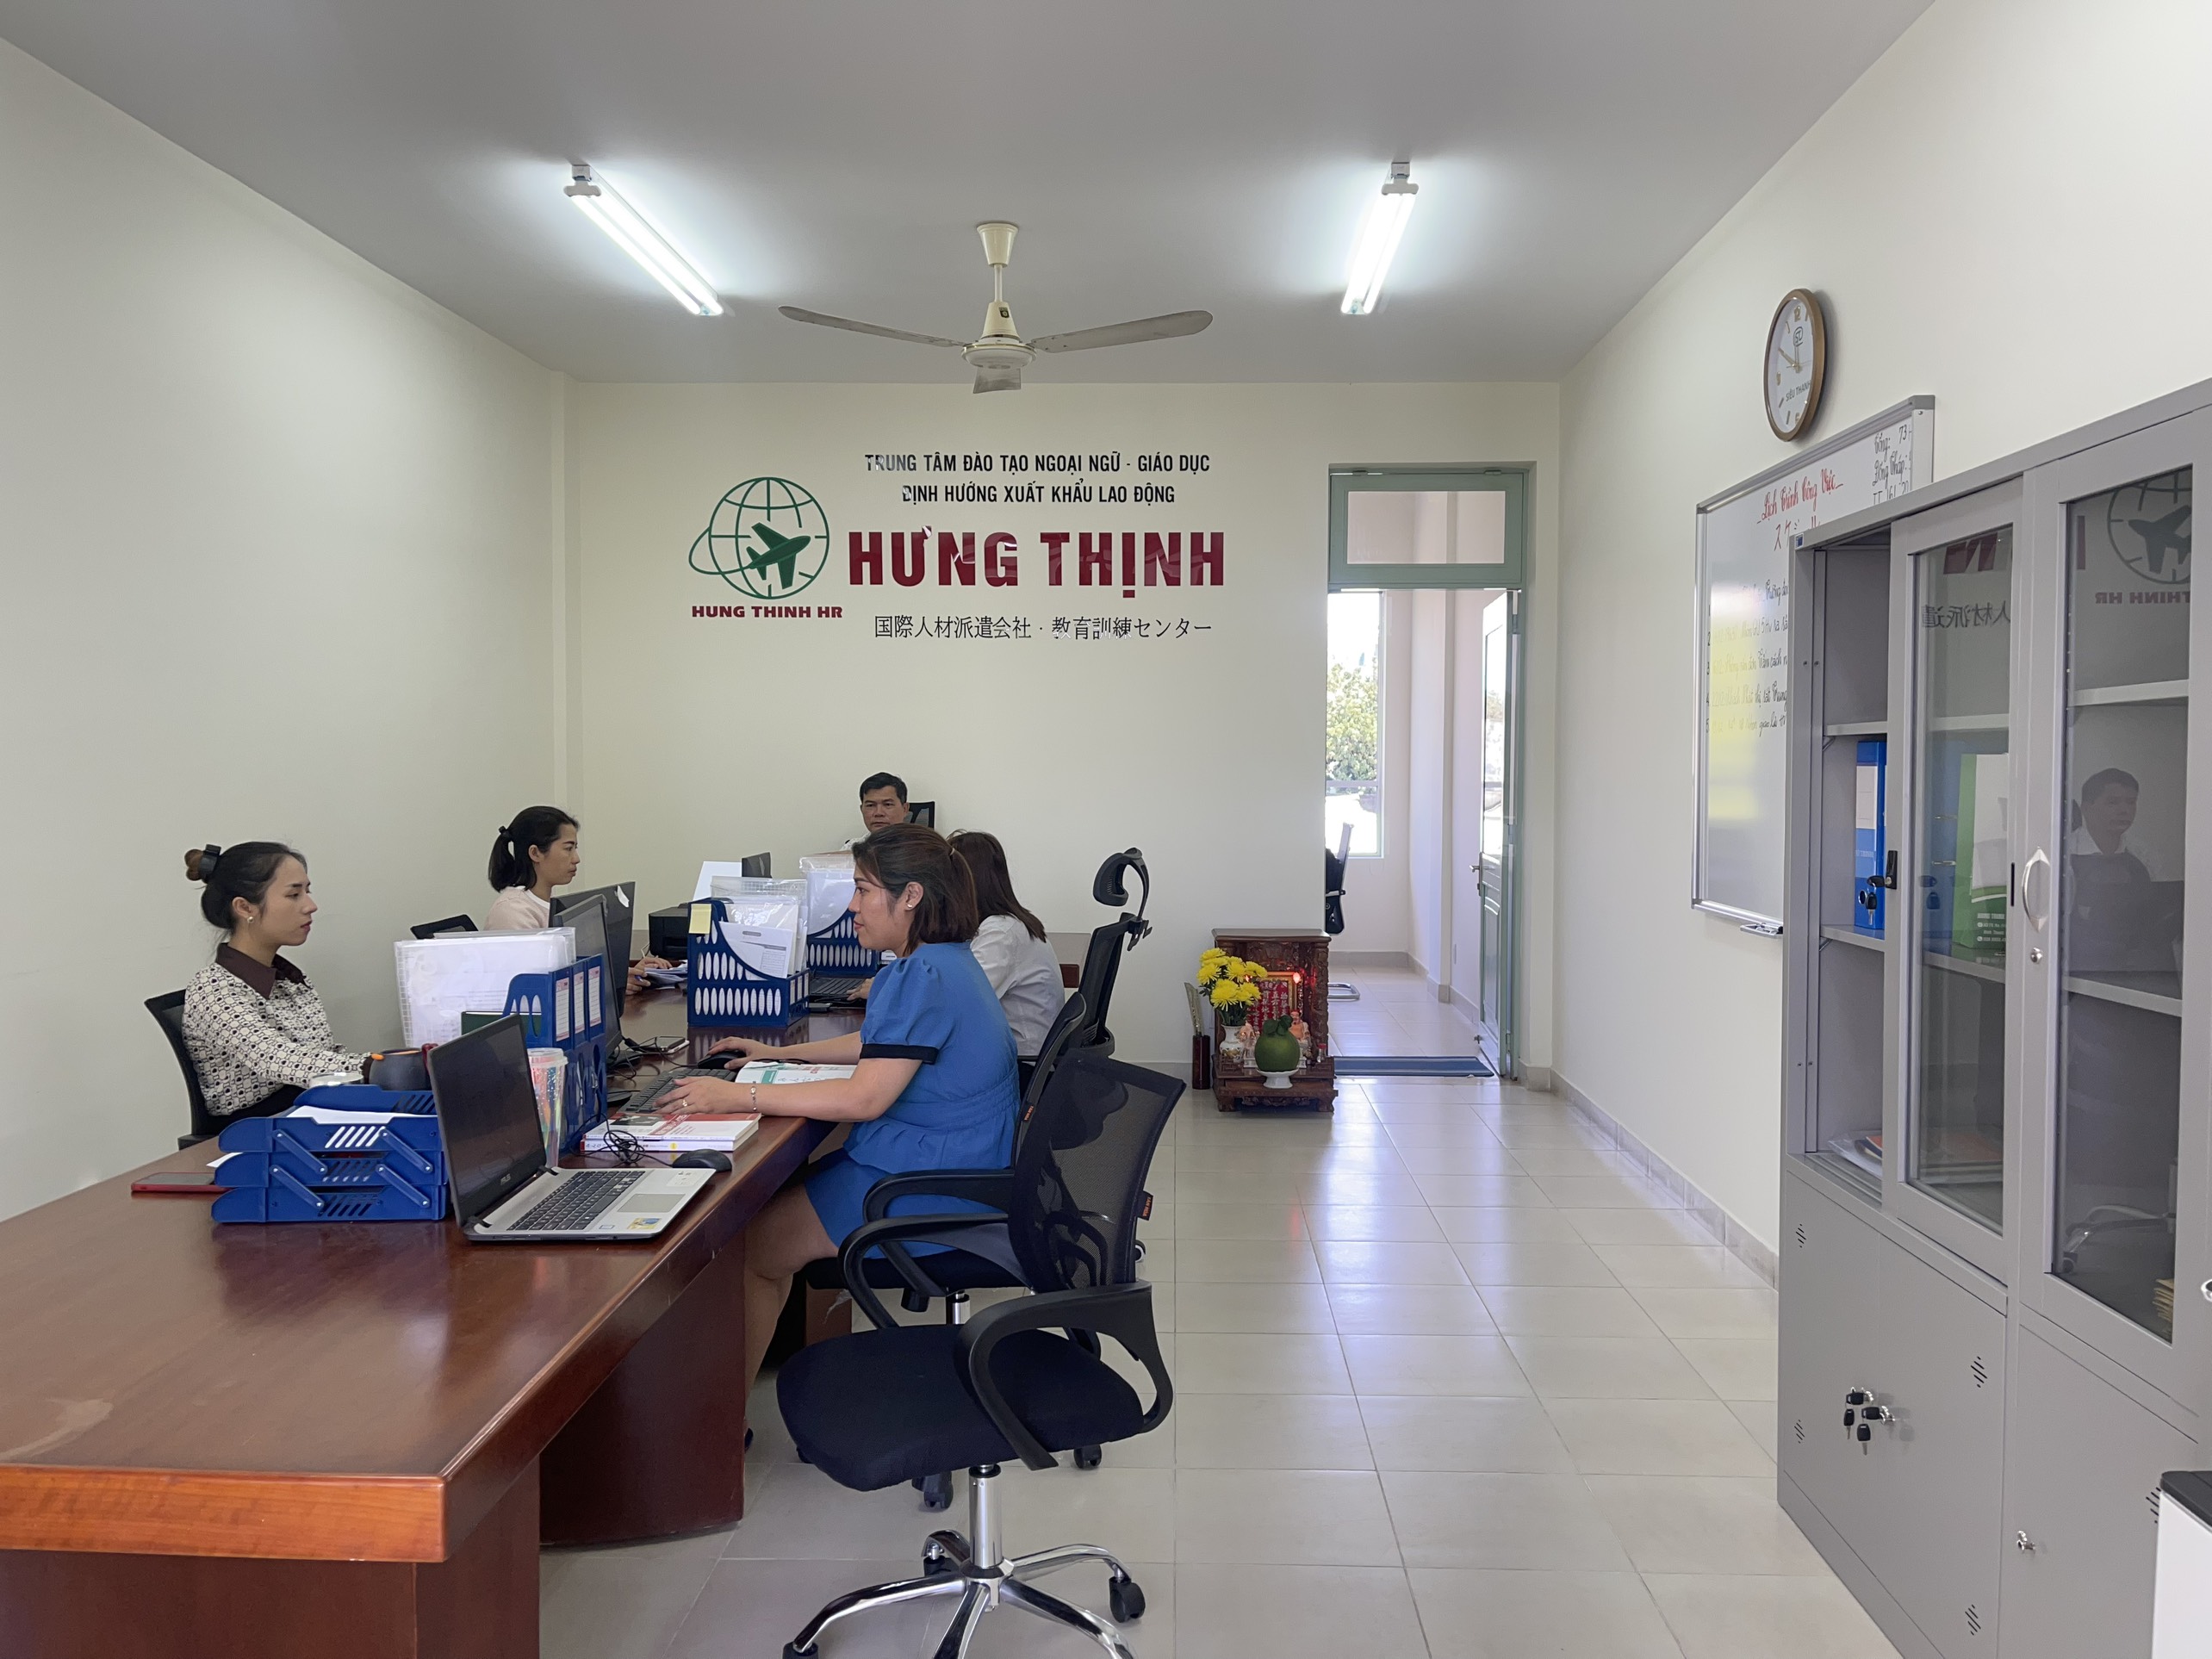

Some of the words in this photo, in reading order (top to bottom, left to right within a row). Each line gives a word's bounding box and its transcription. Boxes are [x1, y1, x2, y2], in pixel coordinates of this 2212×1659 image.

[865, 454, 916, 471] TRUNG
[923, 451, 956, 471] TÂM
[963, 451, 993, 471] ĐÀO
[1000, 455, 1028, 475] TẠO
[1035, 455, 1082, 475] NGOẠI
[1089, 450, 1121, 472] NGỮ
[1138, 451, 1173, 472] GIÁO
[1179, 455, 1210, 475] DỤC
[902, 485, 938, 505] ĐỊNH
[945, 481, 997, 502] HƯỚNG
[1003, 481, 1044, 502] XUẤT
[1052, 478, 1092, 502] KHẨU
[1099, 486, 1127, 502] LAO
[1134, 482, 1175, 506] ĐỘNG
[848, 526, 1018, 587] HƯNG
[1041, 531, 1224, 599] THỊNH
[692, 606, 745, 618] HUNG
[751, 606, 811, 618] THINH
[817, 606, 842, 618] HR
